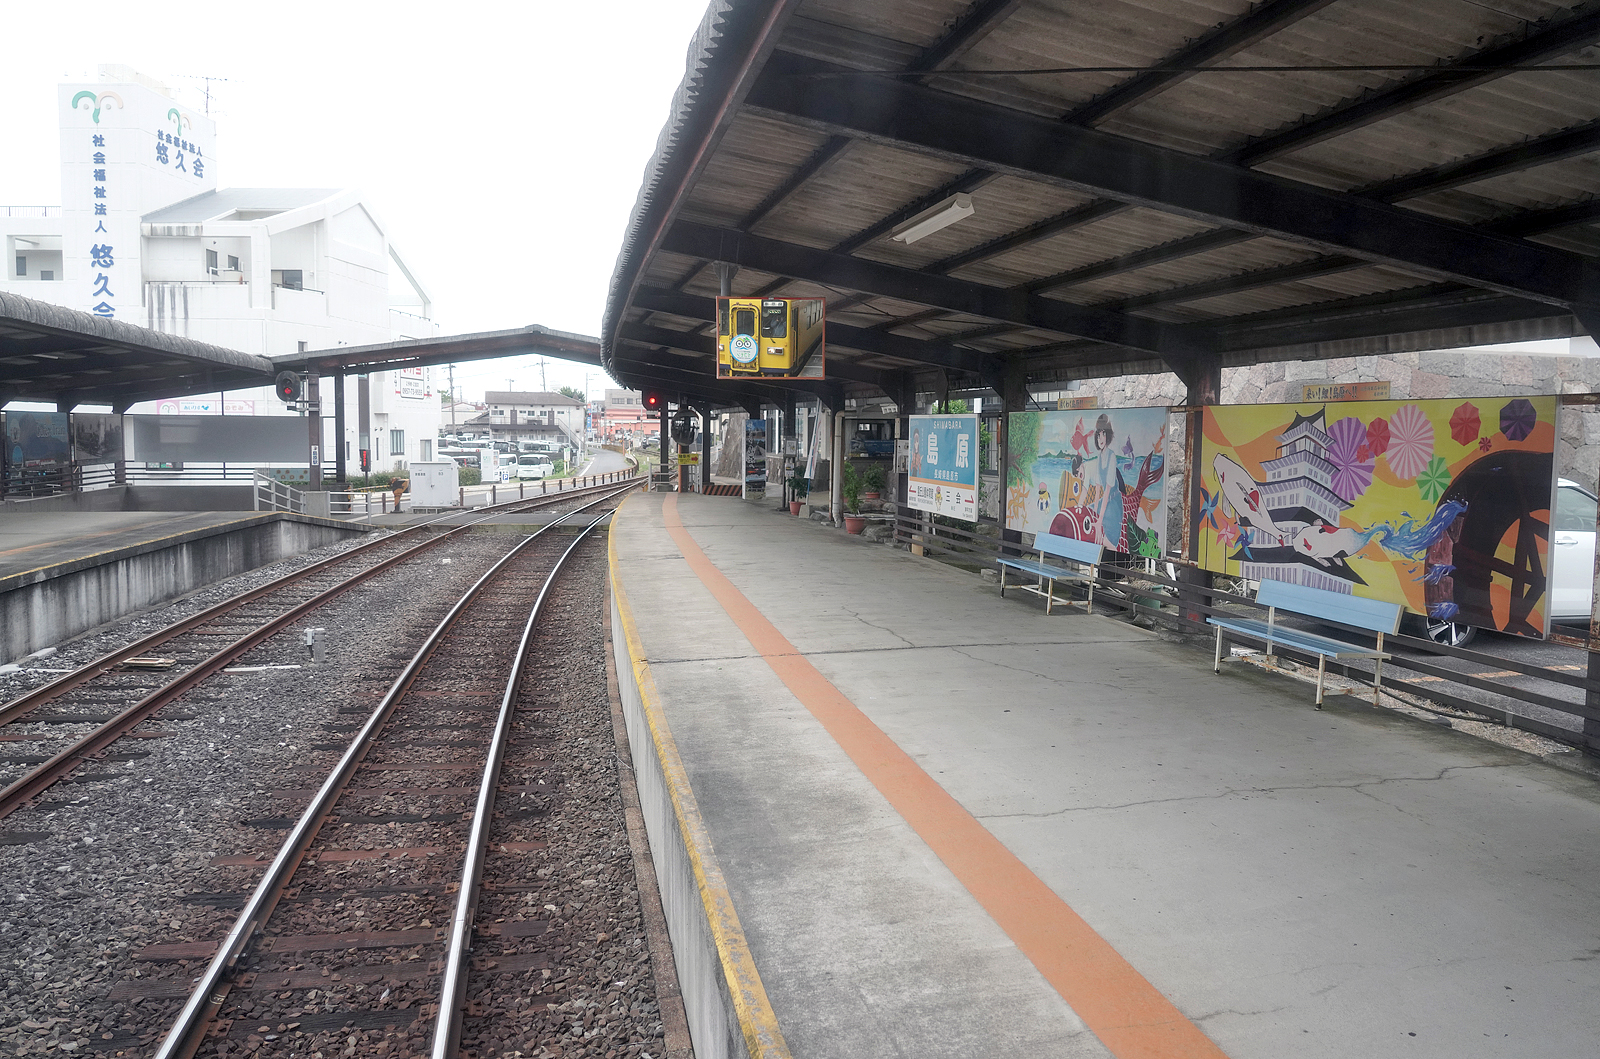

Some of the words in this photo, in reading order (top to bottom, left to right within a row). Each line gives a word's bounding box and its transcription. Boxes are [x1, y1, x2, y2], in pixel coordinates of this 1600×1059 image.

[155, 142, 204, 178] 悠久会
[157, 129, 203, 157] 社会福祉法人
[92, 134, 107, 233] 社会福祉法人
[933, 420, 962, 430] SHIMABARA
[927, 431, 969, 468] 島原
